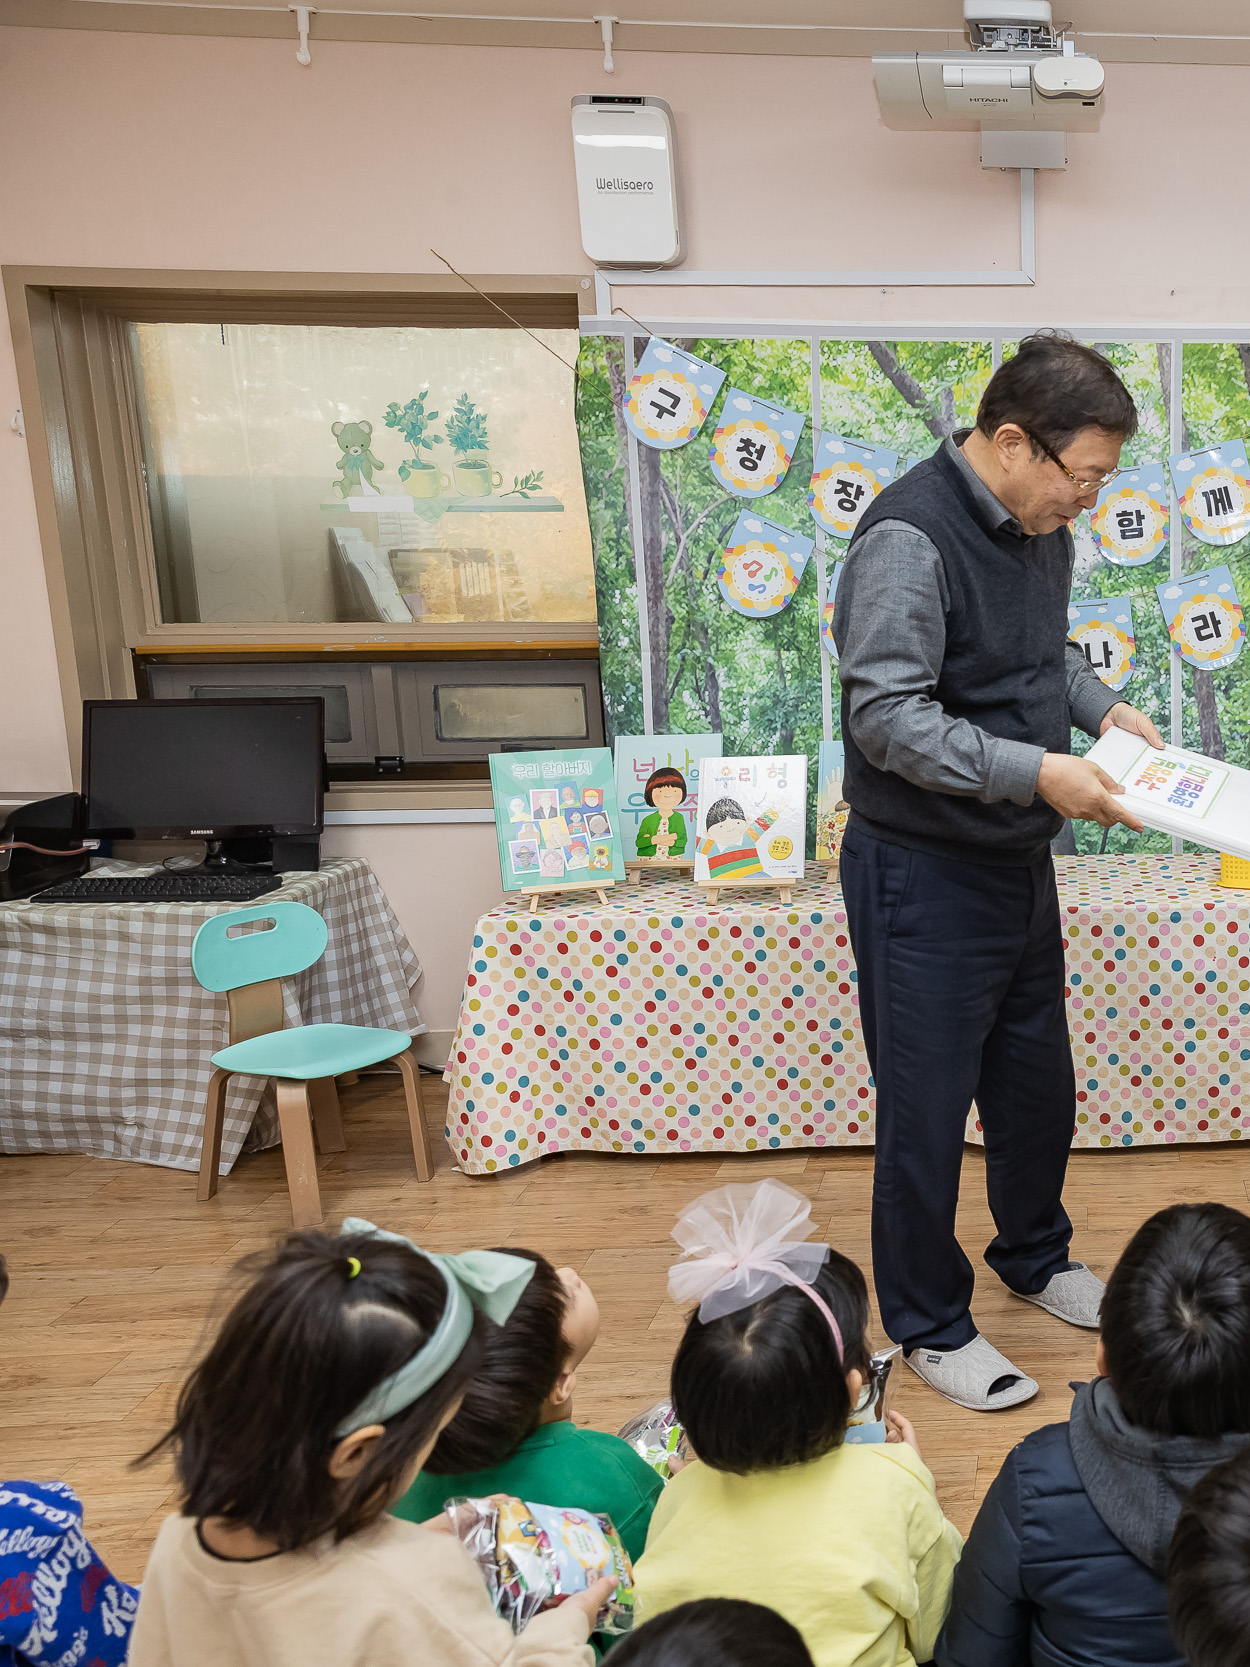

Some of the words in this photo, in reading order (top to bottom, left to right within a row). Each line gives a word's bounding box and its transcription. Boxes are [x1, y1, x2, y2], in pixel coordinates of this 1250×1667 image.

[595, 177, 654, 190] Wellisaero
[511, 763, 540, 779] 우리
[542, 759, 593, 778] 할아버지
[766, 762, 788, 789] 형
[1134, 756, 1178, 791] 구청장님
[1167, 764, 1213, 808] 환영합니다
[621, 792, 699, 825] 우주
